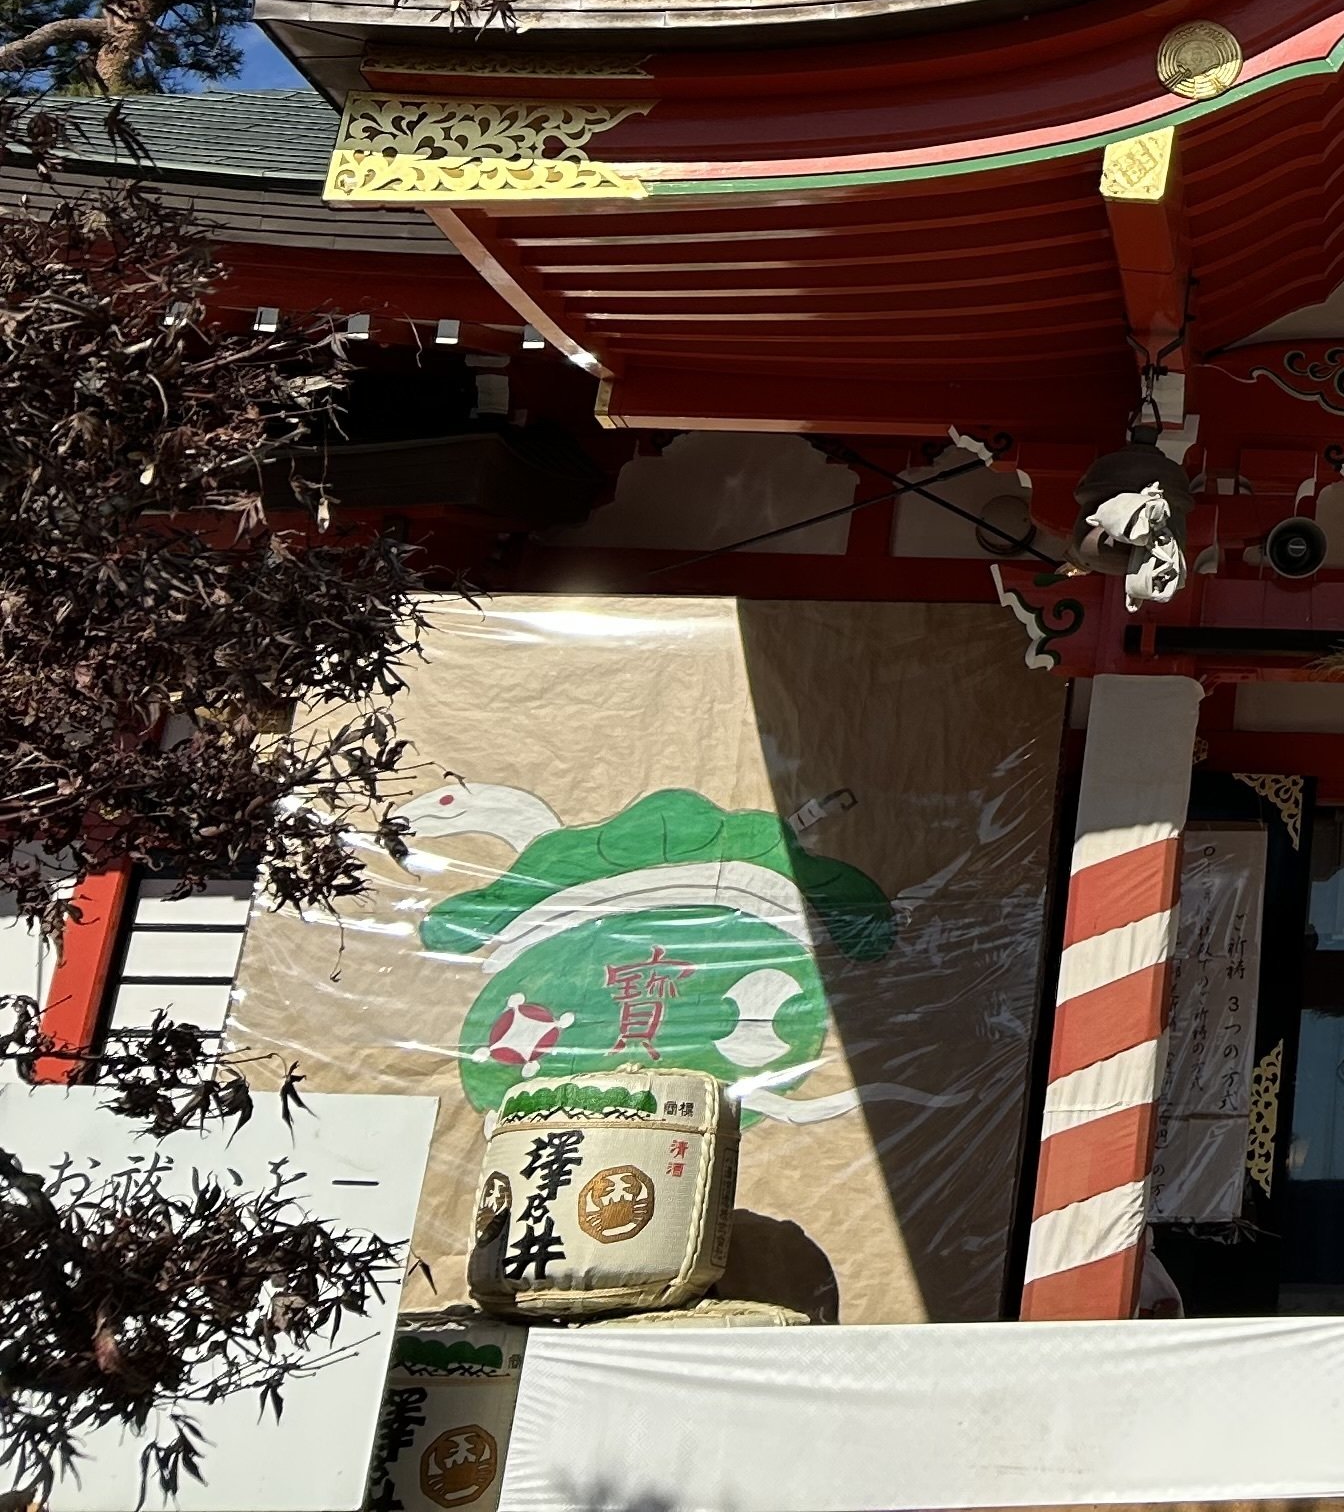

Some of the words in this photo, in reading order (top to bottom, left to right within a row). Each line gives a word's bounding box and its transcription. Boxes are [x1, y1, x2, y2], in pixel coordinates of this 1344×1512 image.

[603, 945, 696, 1062] 寶
[502, 1129, 585, 1280] 澤乃井
[666, 1139, 689, 1178] 清酒
